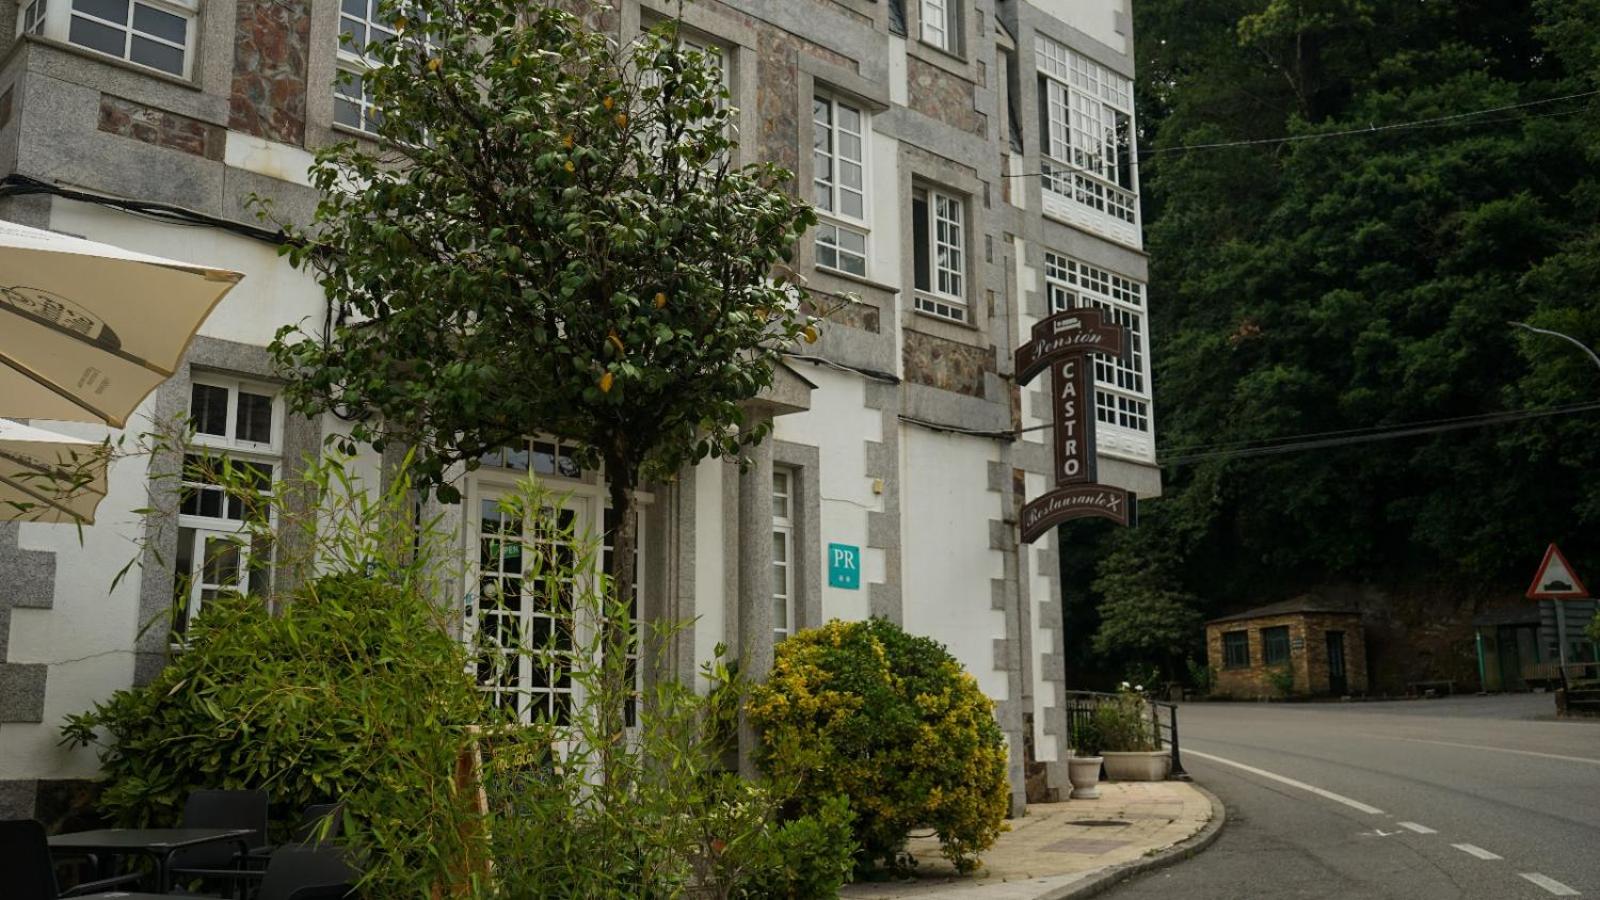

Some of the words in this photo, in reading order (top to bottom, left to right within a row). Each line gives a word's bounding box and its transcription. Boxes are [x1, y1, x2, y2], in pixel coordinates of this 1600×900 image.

[1031, 329, 1101, 360] Pensión
[1062, 362, 1080, 476] CASTRO
[1027, 493, 1107, 527] Restaurante
[834, 549, 855, 570] PR
